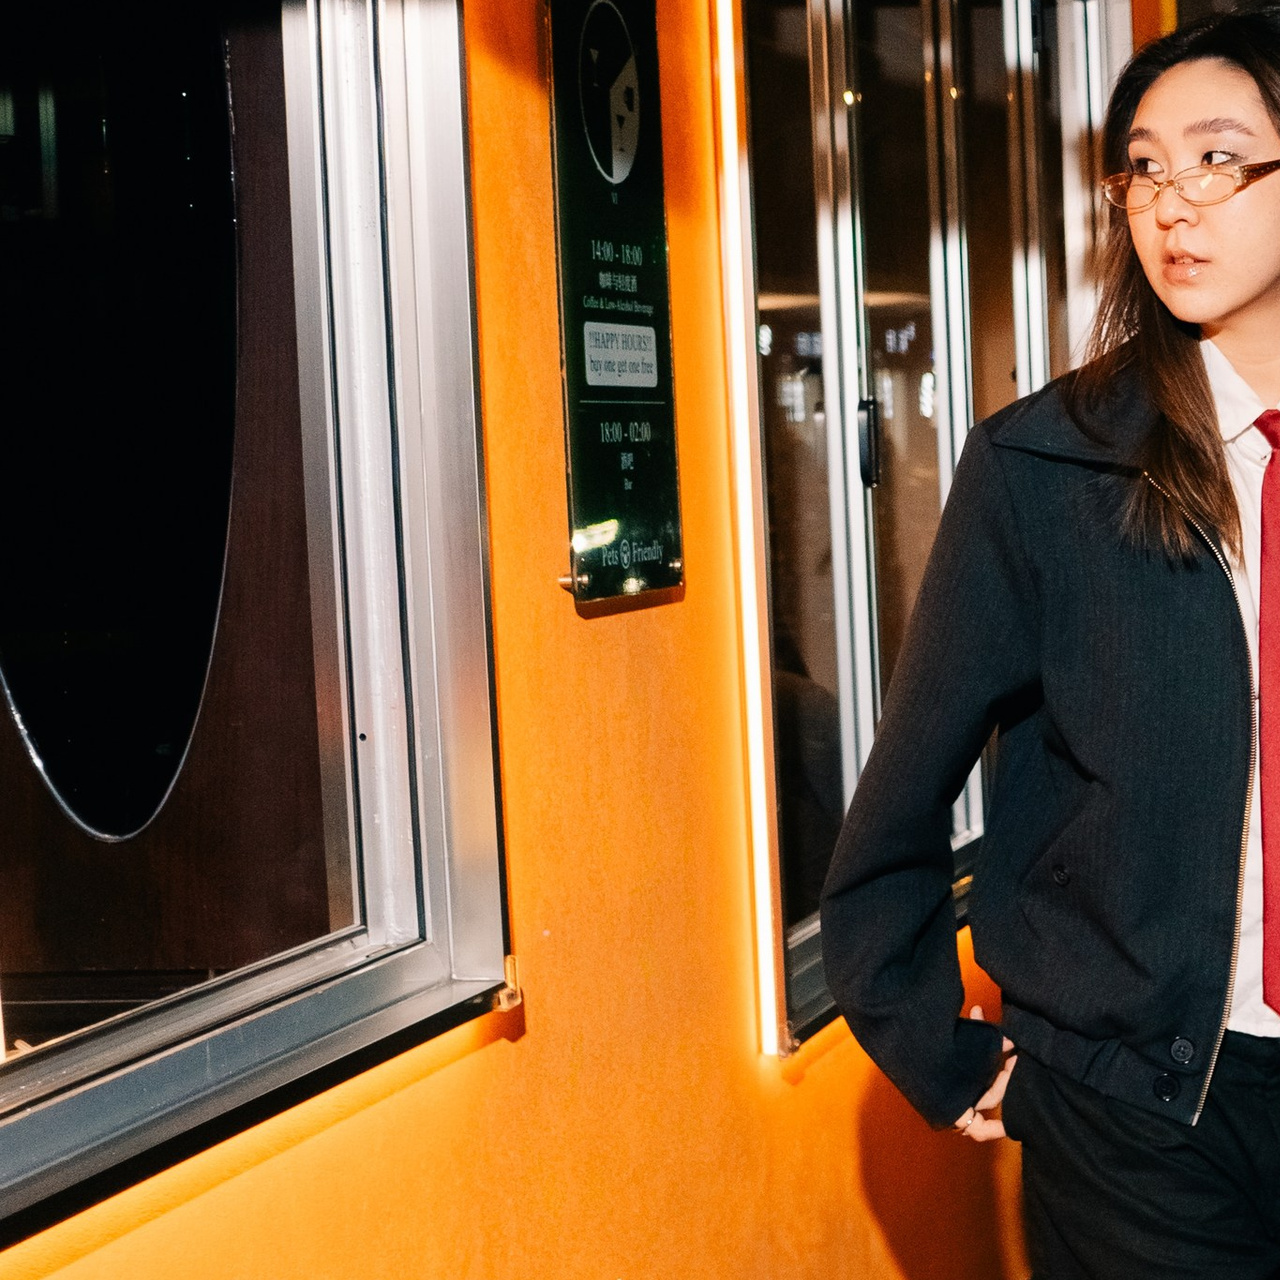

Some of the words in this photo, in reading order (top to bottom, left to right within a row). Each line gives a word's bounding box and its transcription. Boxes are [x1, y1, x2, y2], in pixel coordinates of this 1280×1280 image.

[591, 239, 614, 262] 14:00
[621, 244, 643, 266] 18:00
[583, 295, 599, 308] Coffee
[589, 354, 602, 376] buy
[603, 360, 616, 373] one
[617, 359, 627, 377] get
[628, 361, 640, 374] one
[641, 356, 653, 375] free
[600, 422, 622, 442] 18:00
[629, 422, 651, 442] 02:00
[620, 452, 634, 470] 酒吧
[624, 478, 633, 490] Bar
[602, 545, 618, 567] Pets
[632, 540, 663, 564] Friendly
